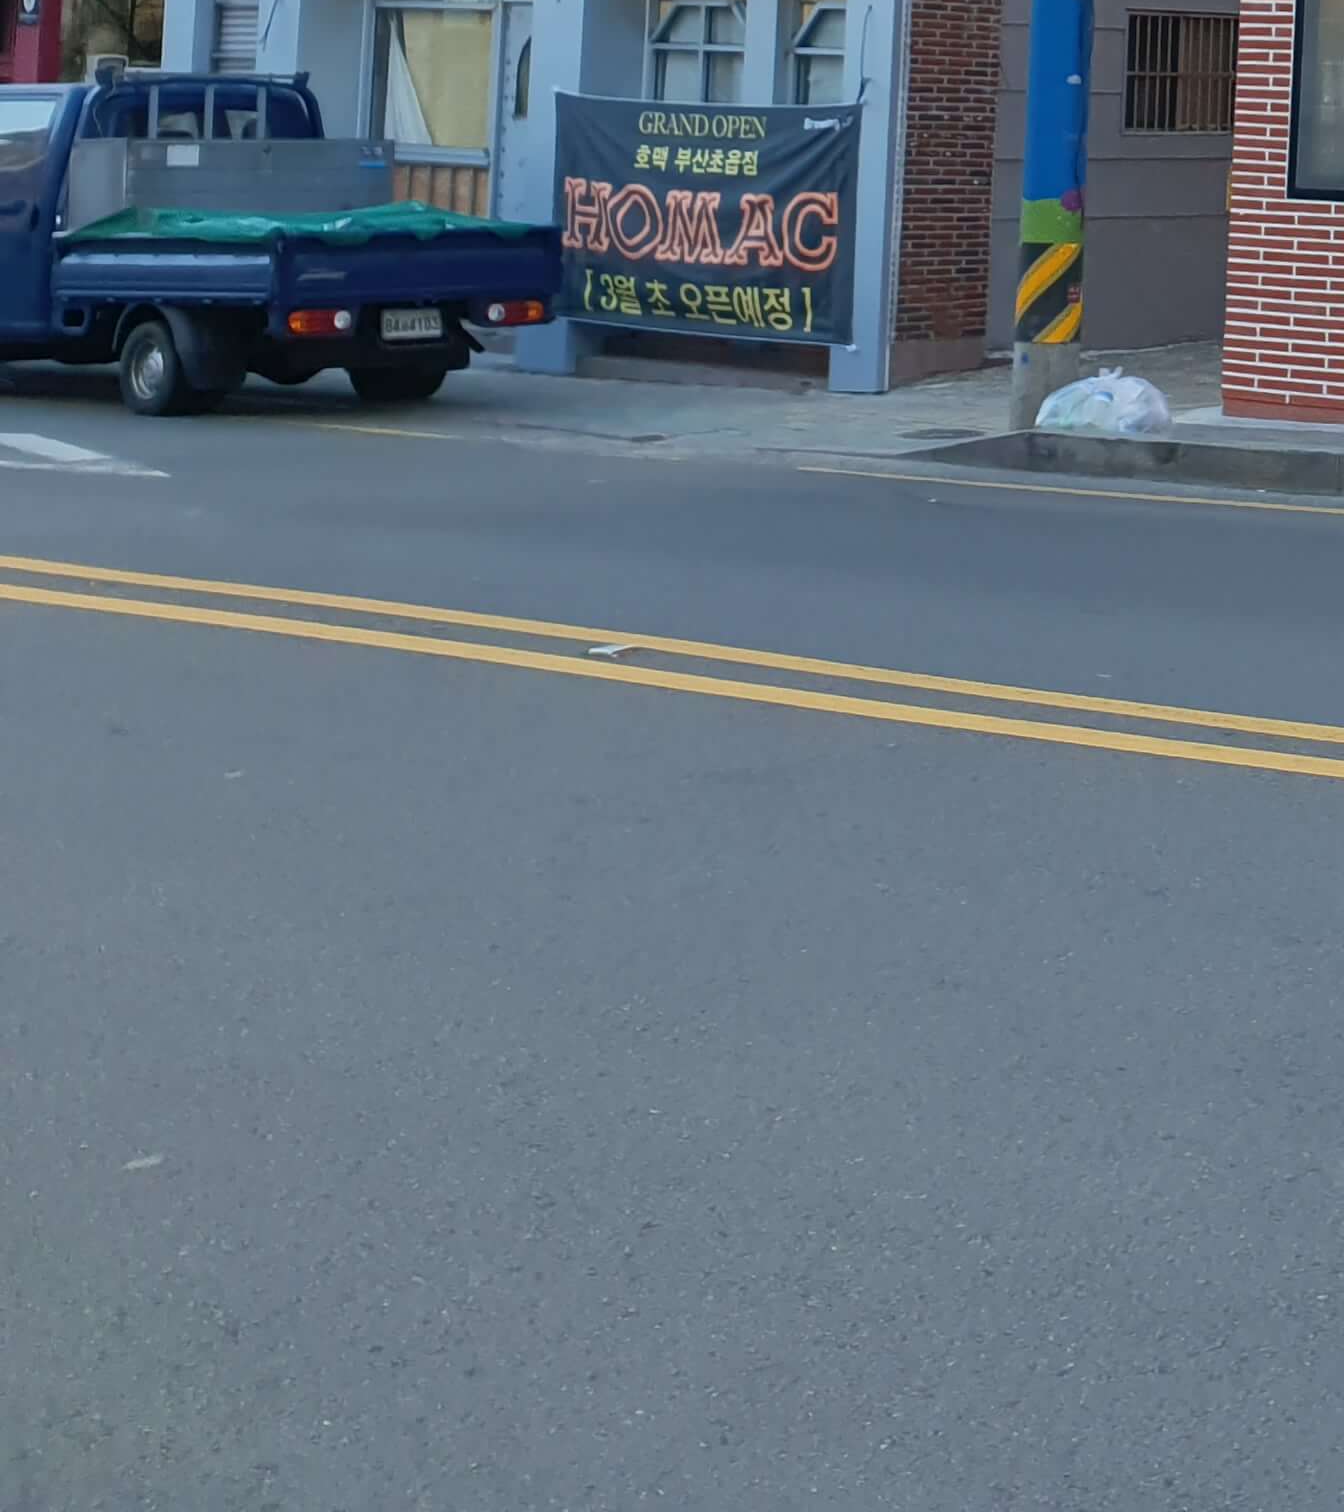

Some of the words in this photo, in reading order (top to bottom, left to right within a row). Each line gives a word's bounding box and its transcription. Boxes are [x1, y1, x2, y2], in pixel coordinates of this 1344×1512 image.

[638, 111, 709, 136] GRAND
[712, 115, 767, 138] OPEN
[633, 144, 669, 171] 호맥
[674, 147, 759, 176] 부산초읍점
[562, 176, 839, 271] HOMAC
[600, 274, 643, 316] 3월
[645, 279, 676, 317] 초
[680, 283, 793, 331] 오픈예정
